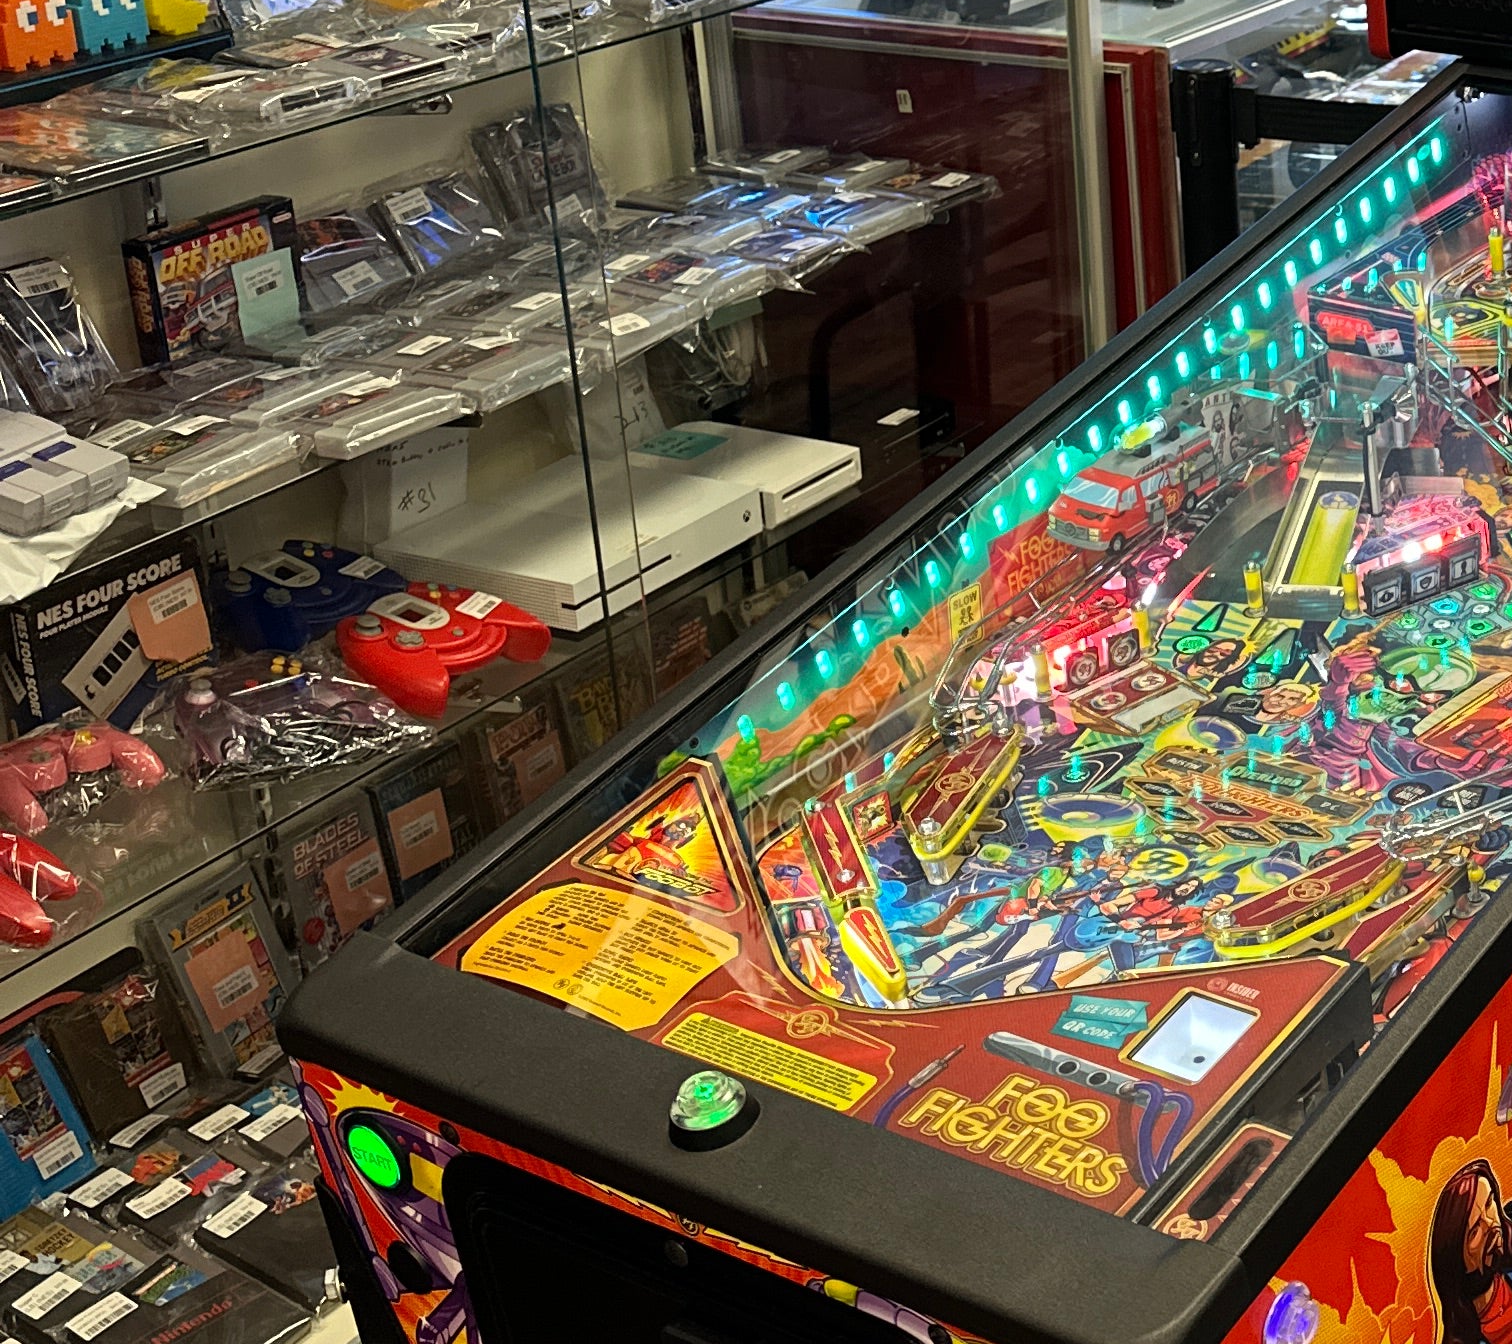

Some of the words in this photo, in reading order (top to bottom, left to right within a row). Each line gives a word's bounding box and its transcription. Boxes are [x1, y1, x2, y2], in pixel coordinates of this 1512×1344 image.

[160, 250, 208, 285] OFF
[207, 224, 270, 264] ROAD
[173, 222, 251, 256] SUPER
[37, 599, 74, 630] NES
[76, 578, 125, 613] FOUR
[127, 553, 182, 591] SCORE
[952, 590, 978, 609] SLOW
[15, 613, 28, 636] NES
[19, 637, 35, 676] FOUR
[25, 675, 43, 719] SCORE
[1232, 765, 1303, 787] OVERLORD
[292, 812, 360, 861] BLADES
[294, 857, 315, 879] OF
[314, 830, 370, 868] STEEL
[1227, 981, 1260, 1000] INSIDER
[1073, 1002, 1098, 1016] USE
[1100, 1004, 1137, 1020] YOUR
[1061, 1019, 1081, 1034] QR
[1082, 1023, 1116, 1041] CODE
[990, 1076, 1107, 1137] FOO
[351, 1146, 392, 1171] START
[907, 1091, 1128, 1194] FIGHTERS
[40, 1232, 75, 1257] HOCKEY
